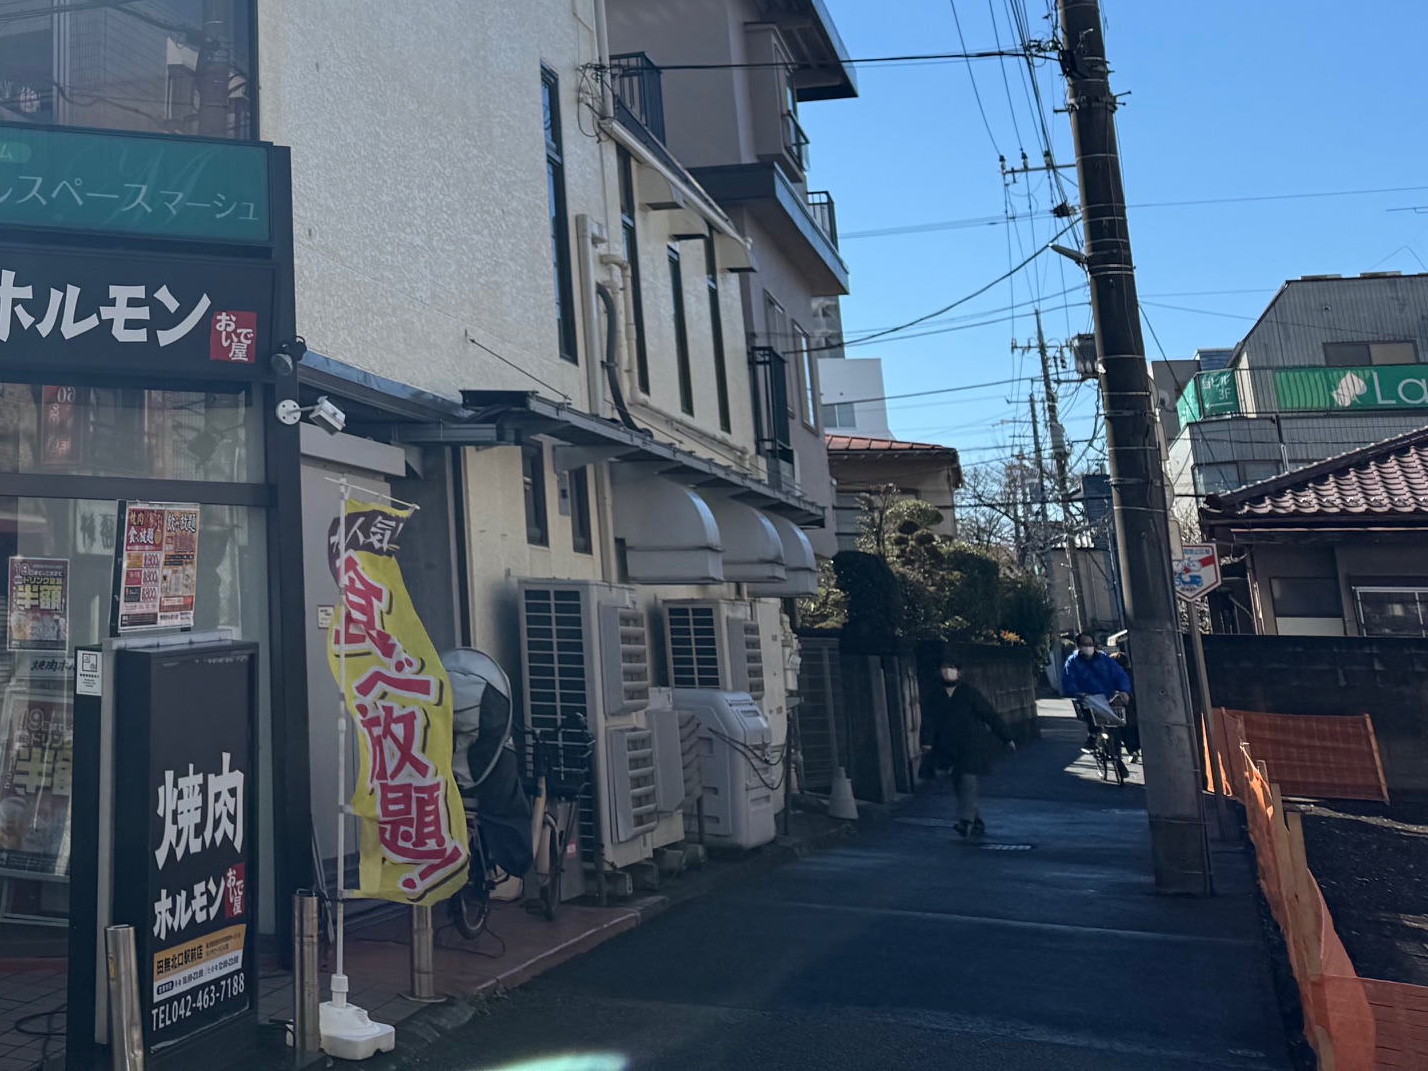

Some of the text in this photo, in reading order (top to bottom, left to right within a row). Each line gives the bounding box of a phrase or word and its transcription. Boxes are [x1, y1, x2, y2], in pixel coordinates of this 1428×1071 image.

[214, 312, 254, 362] おいで屋
[154, 751, 244, 871] 焼肉
[153, 875, 225, 941] ホルモン
[225, 867, 244, 914] おいで屋
